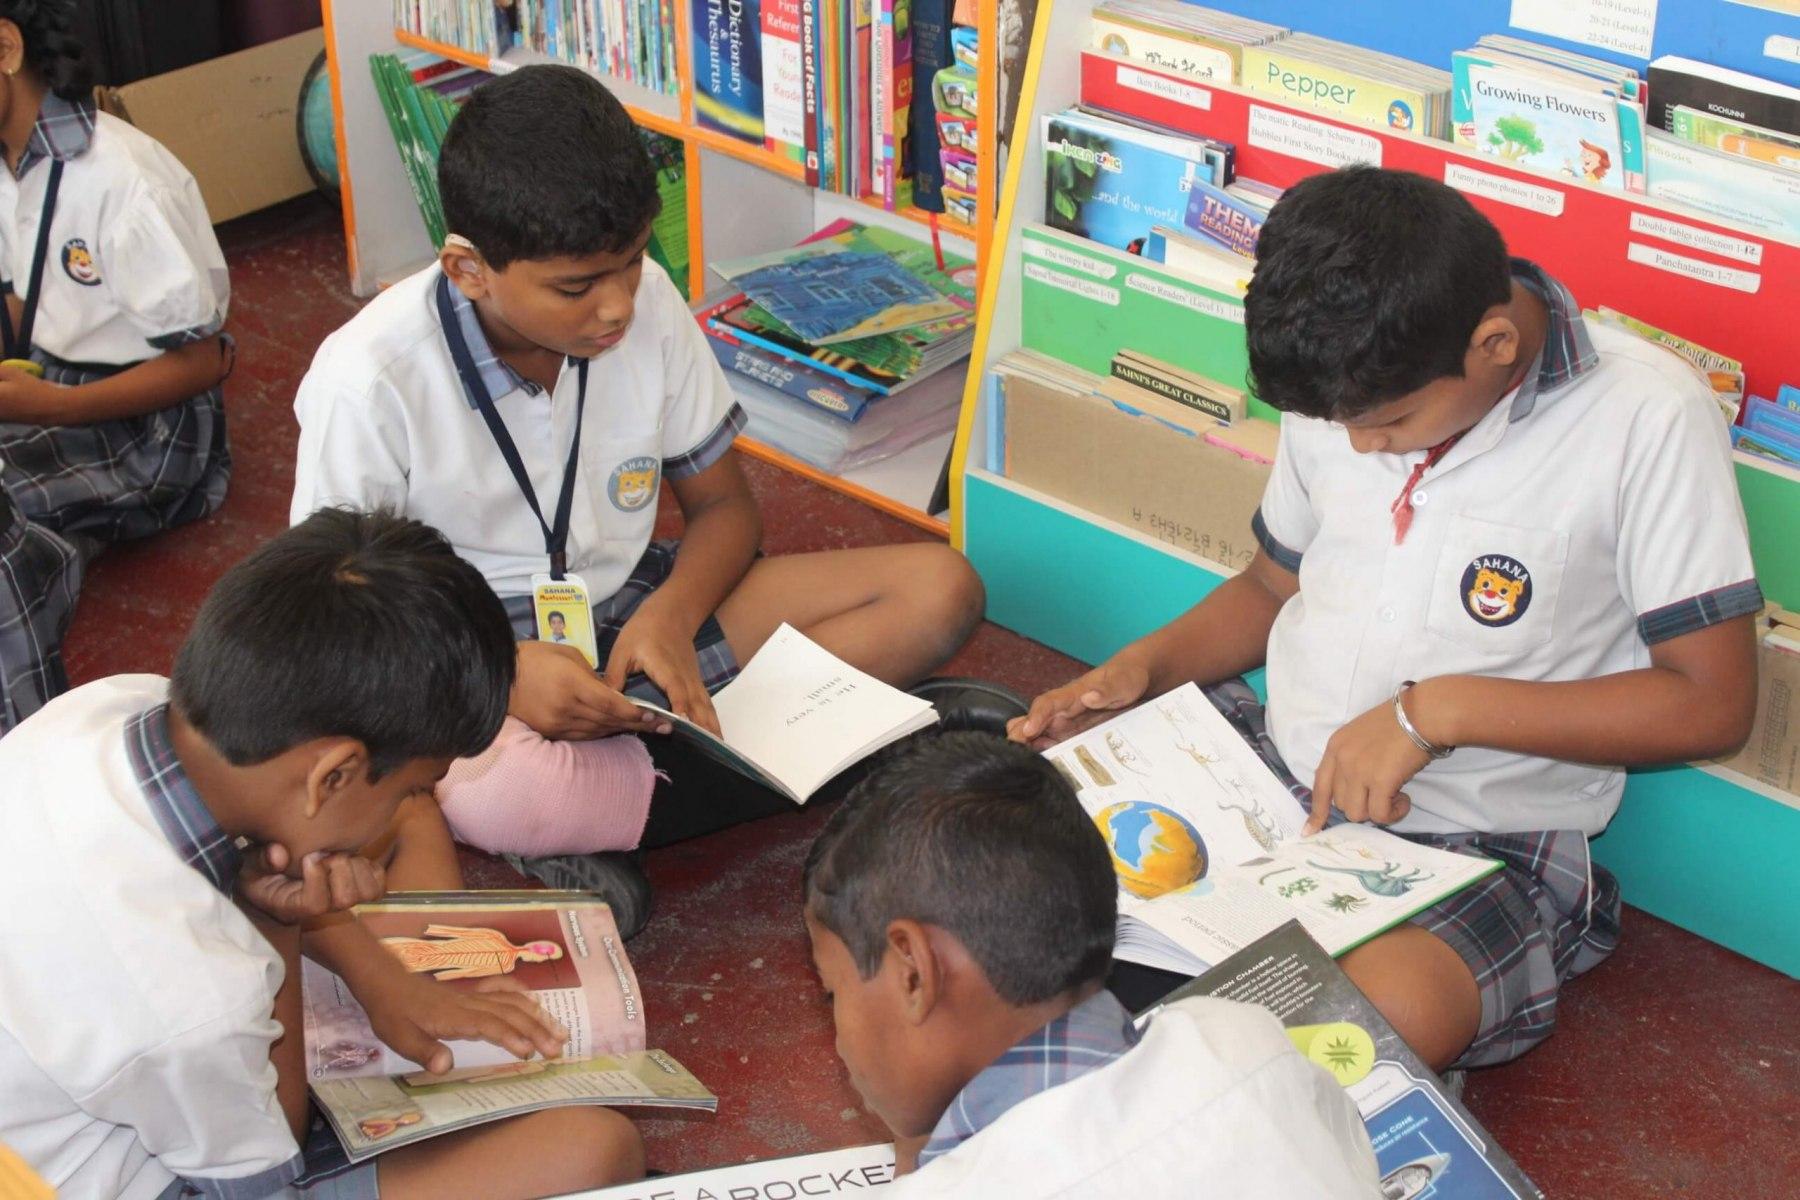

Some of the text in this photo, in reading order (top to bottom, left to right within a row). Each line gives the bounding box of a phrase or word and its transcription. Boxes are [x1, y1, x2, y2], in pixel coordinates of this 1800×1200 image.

[708, 0, 722, 94] Thesaurus
[728, 0, 743, 97] Dictionary
[804, 14, 813, 53] Book
[805, 56, 815, 73] of
[806, 75, 816, 113] Facts
[1267, 62, 1356, 104] Pepper
[1476, 80, 1542, 110] Growing
[1546, 95, 1607, 123] Flowers
[1291, 117, 1323, 136] Reading
[1283, 133, 1301, 147] First
[1303, 140, 1324, 156] Story
[1122, 194, 1141, 213] the
[1144, 204, 1179, 222] world
[1204, 195, 1262, 240] THEM
[1200, 212, 1253, 249] READING
[1638, 218, 1667, 233] Double
[1669, 226, 1693, 240] fables
[1694, 232, 1735, 252] collection
[1655, 253, 1733, 282] Panchatantra 1-7
[1128, 276, 1158, 292] Science
[735, 351, 794, 382] STARS AND
[1116, 364, 1228, 418] SAHNI'S GREAT CLASSICS
[1472, 557, 1529, 584] SAHANA
[837, 683, 856, 696] He
[785, 708, 814, 728] very
[1236, 955, 1275, 981] CHAMBER
[624, 995, 637, 1020] Tools
[1389, 1115, 1413, 1133] CONE
[728, 1162, 896, 1200] ROCKE
